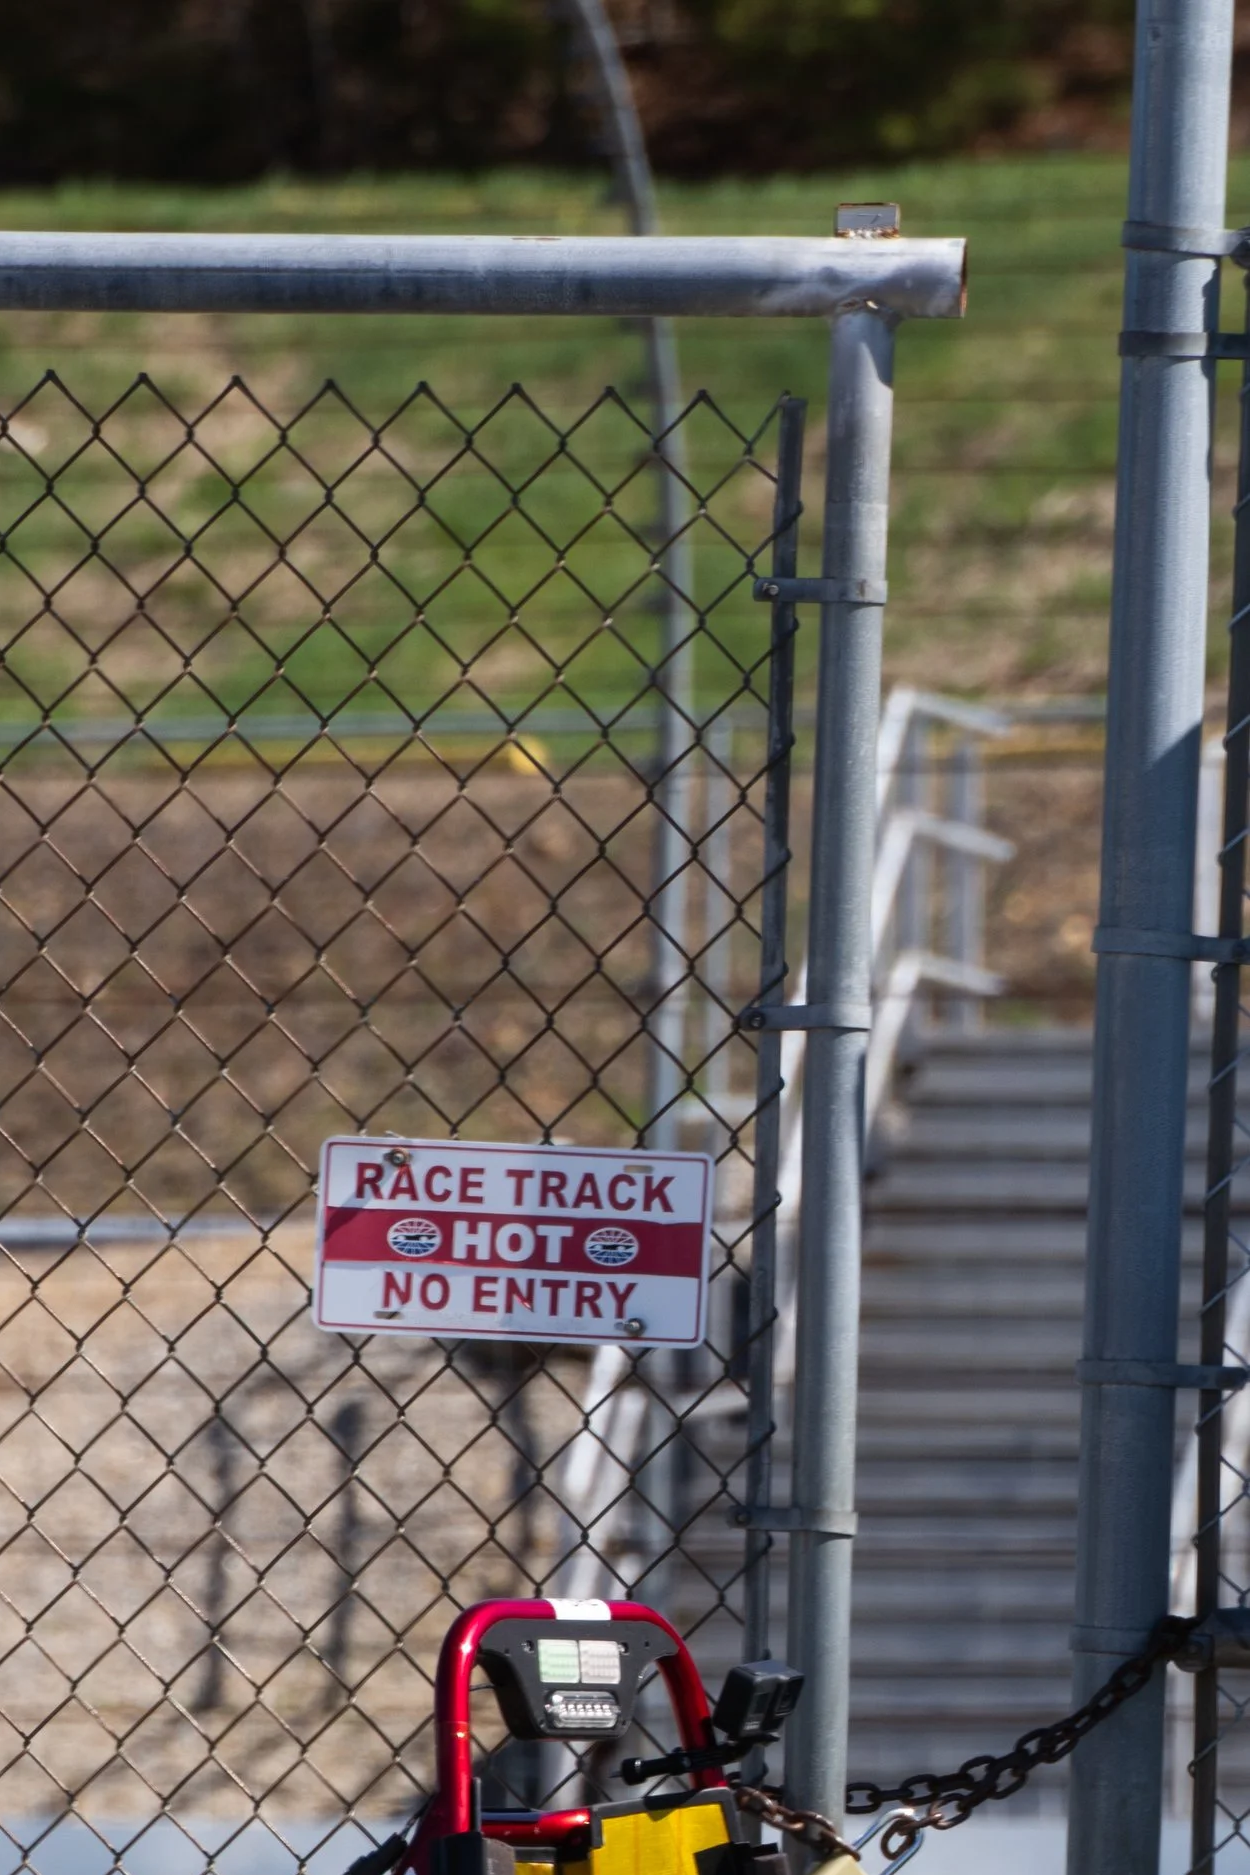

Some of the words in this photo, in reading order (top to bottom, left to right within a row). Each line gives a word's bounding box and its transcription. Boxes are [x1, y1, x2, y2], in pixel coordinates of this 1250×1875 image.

[355, 1162, 485, 1204] RACE
[505, 1168, 677, 1213] TRACK
[452, 1220, 574, 1263] HOT
[381, 1271, 450, 1310] NO
[472, 1276, 638, 1320] ENTRY
